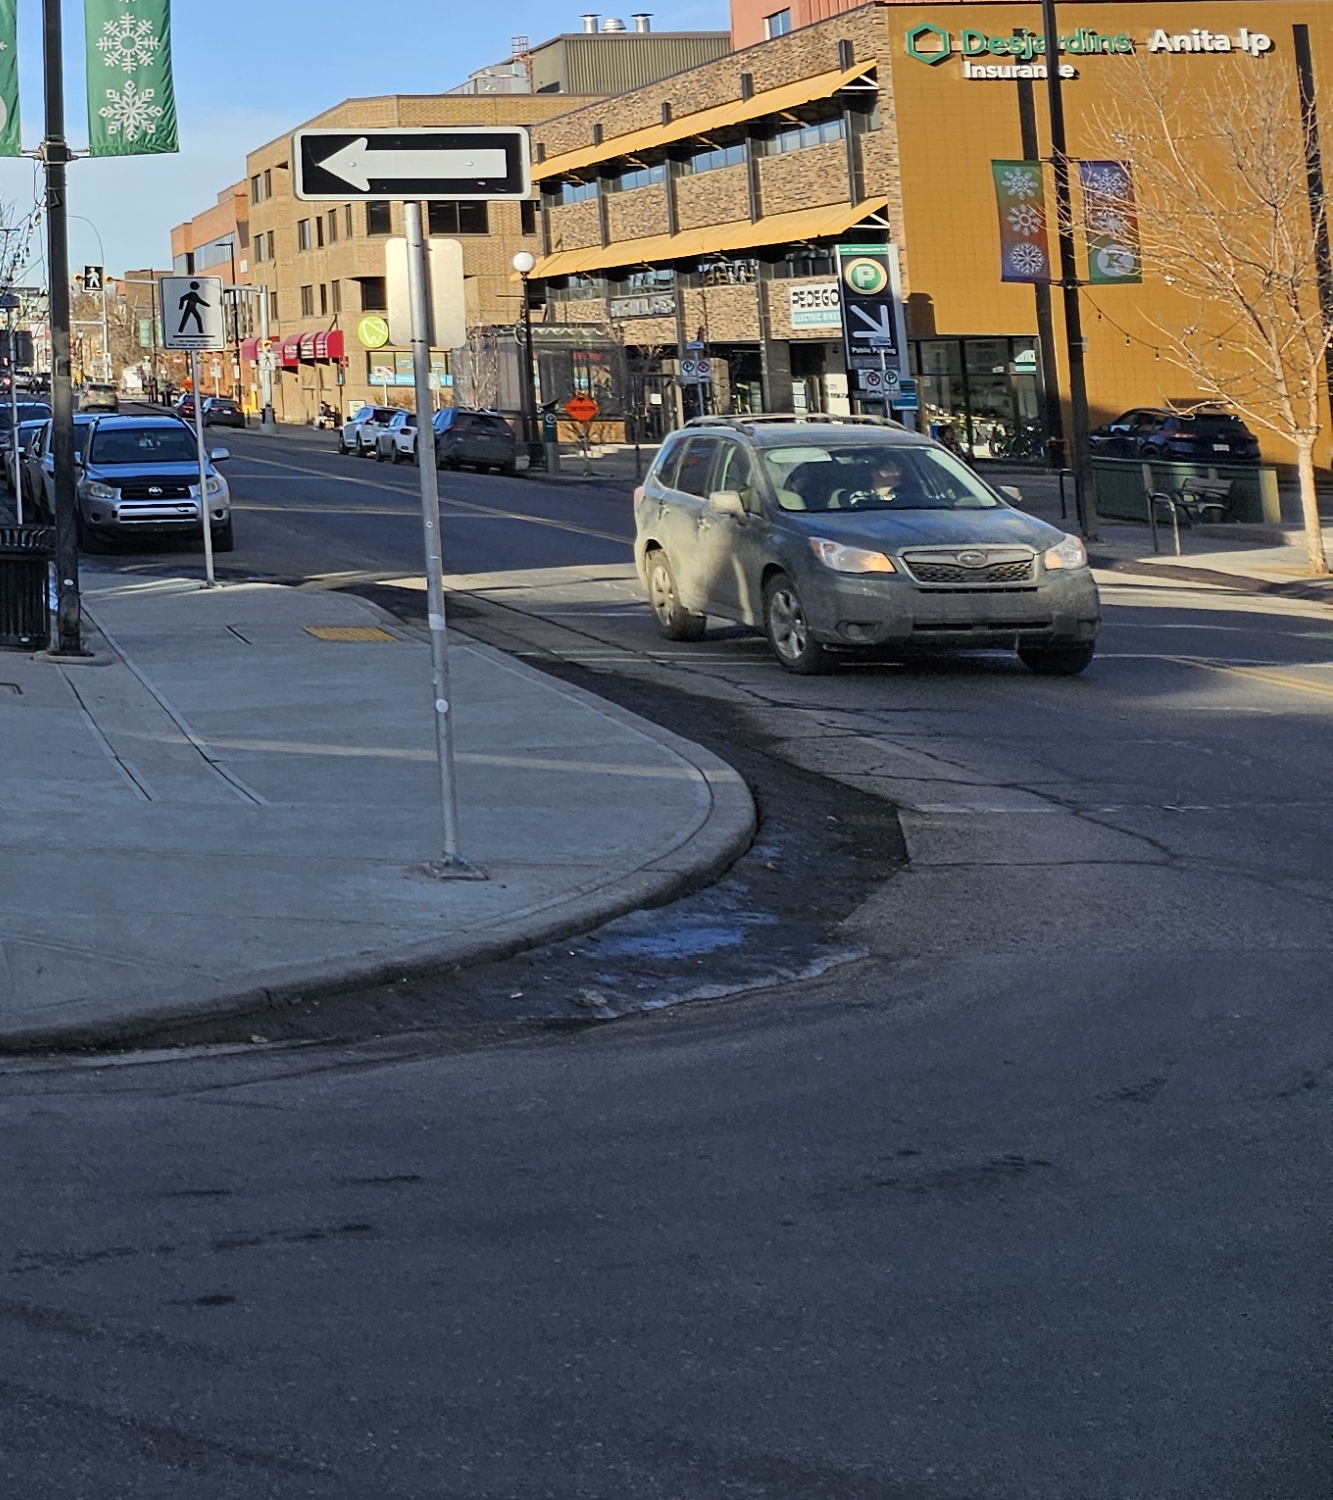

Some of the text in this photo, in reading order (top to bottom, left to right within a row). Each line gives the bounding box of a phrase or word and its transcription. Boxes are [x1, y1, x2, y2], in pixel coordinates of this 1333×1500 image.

[1149, 28, 1232, 52] Anita
[962, 60, 1075, 79] Insurane
[792, 288, 840, 309] PEDEGO
